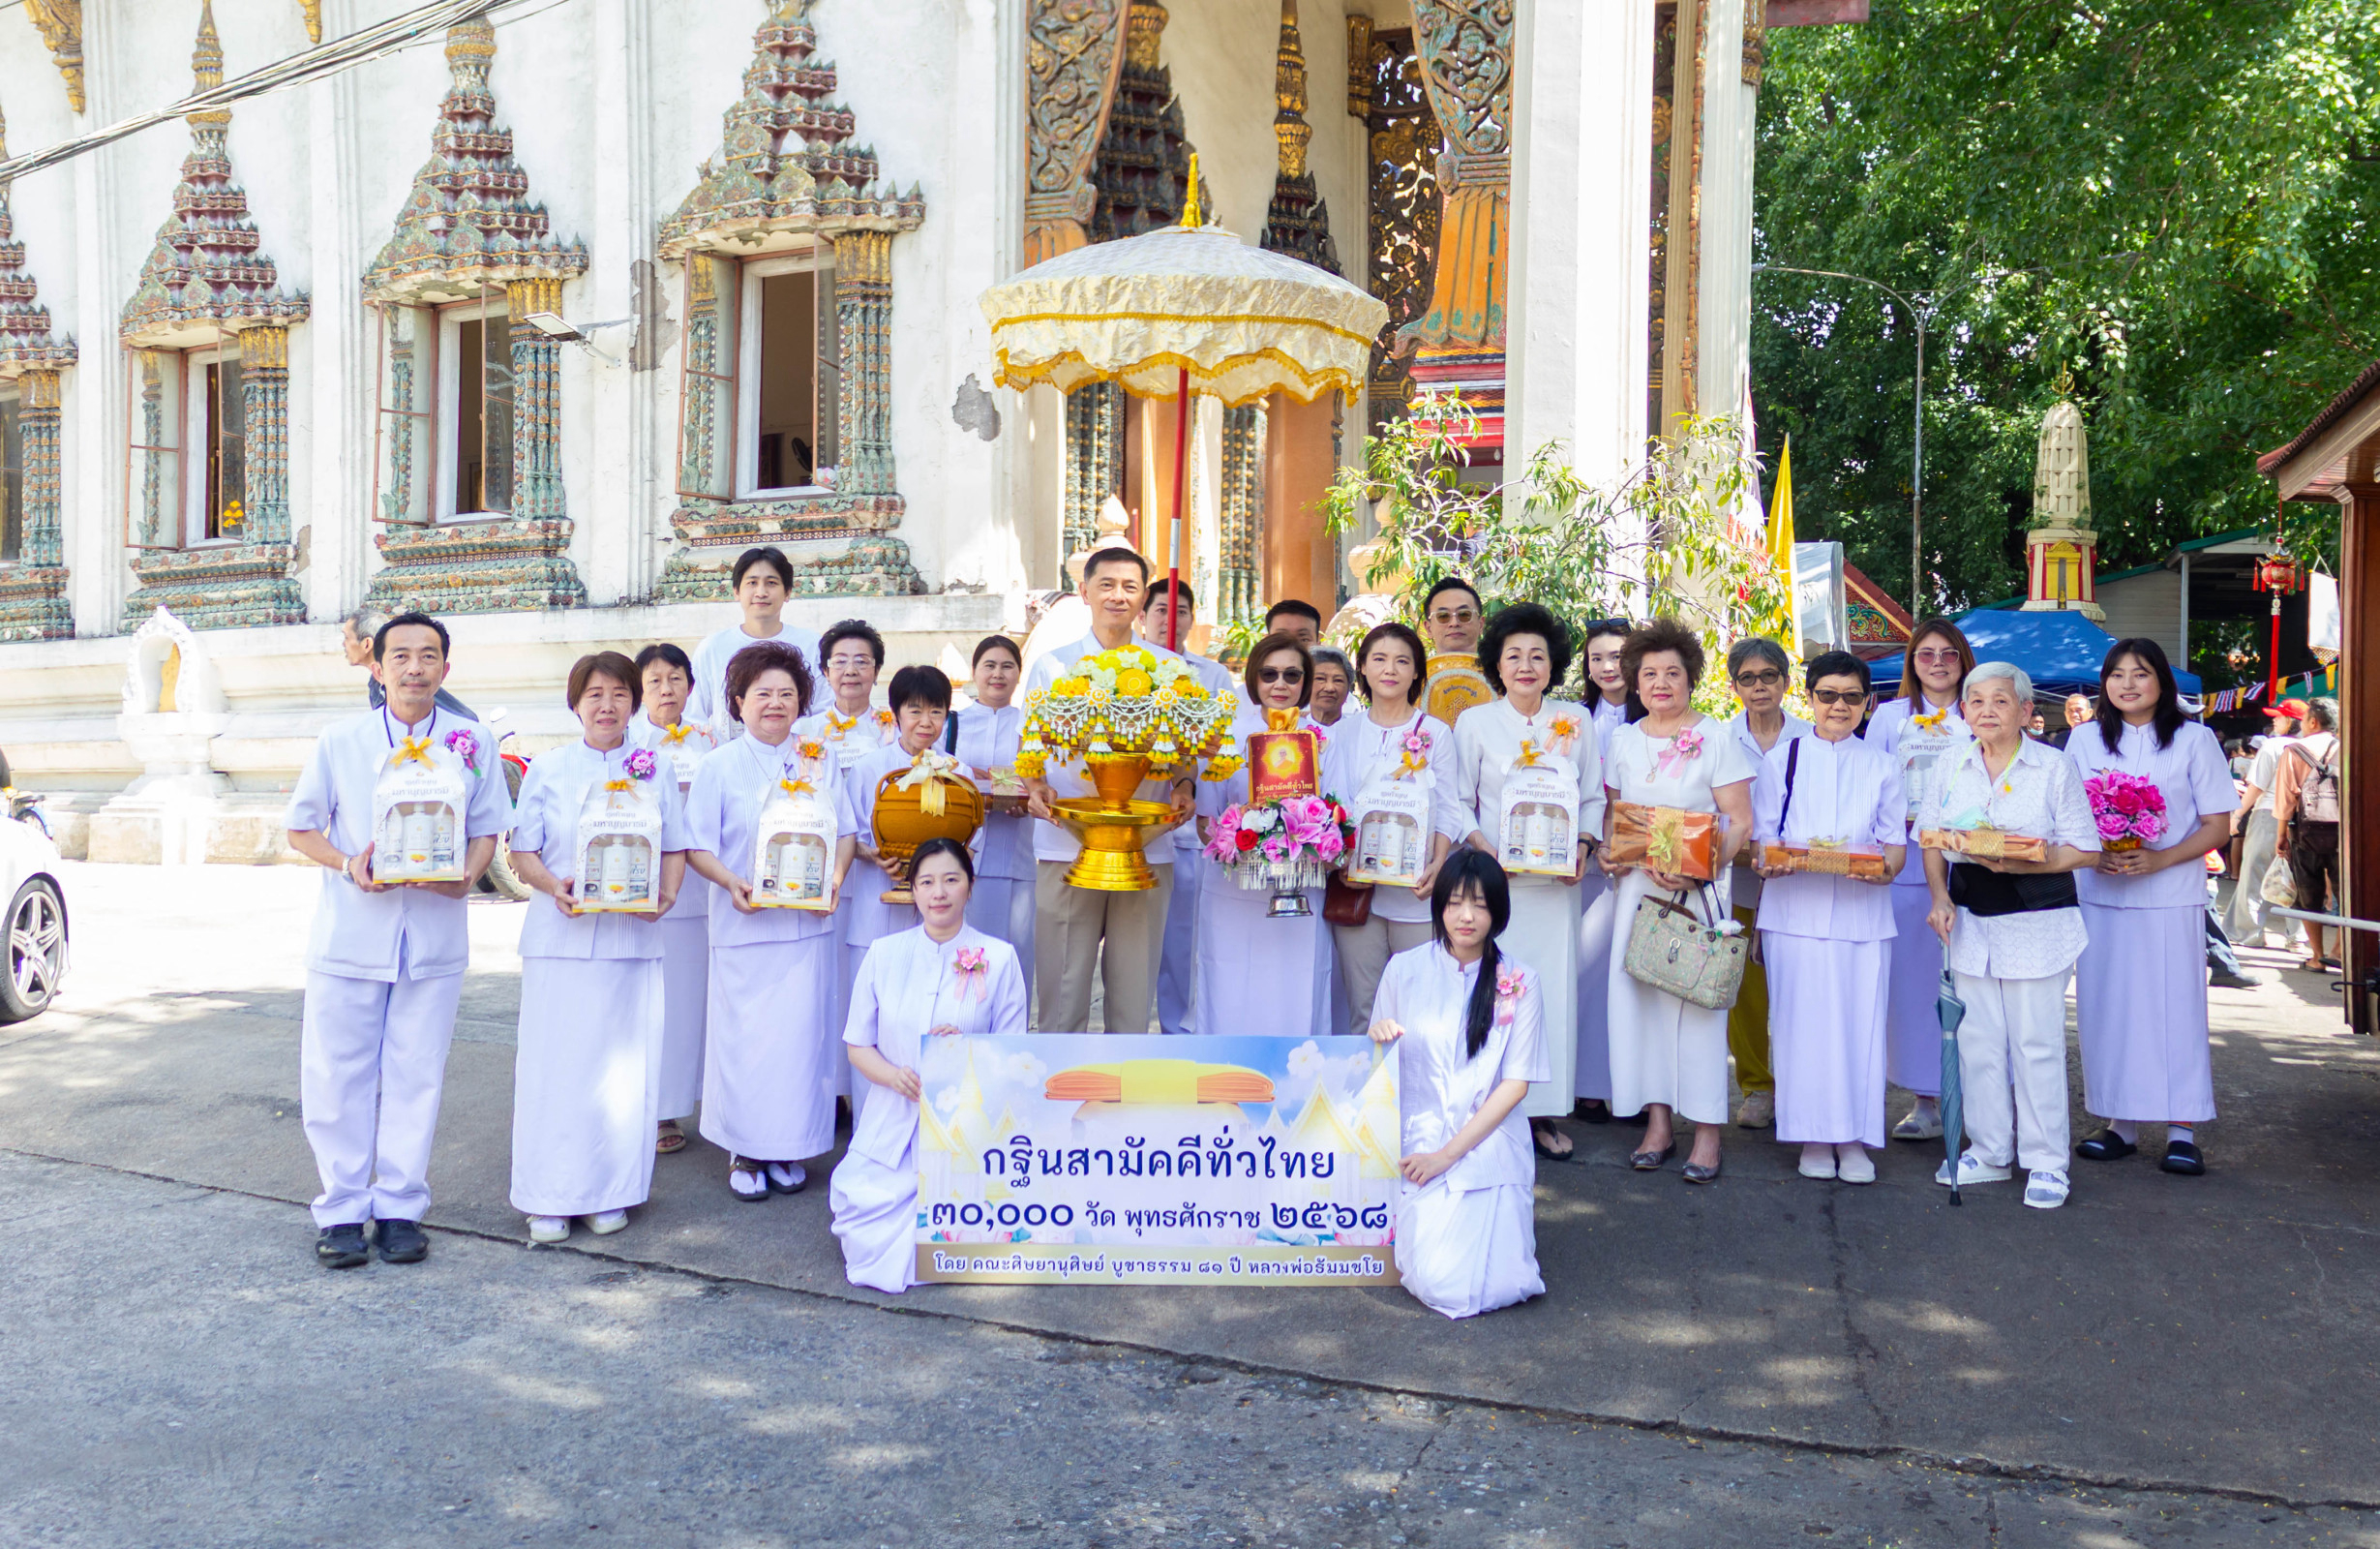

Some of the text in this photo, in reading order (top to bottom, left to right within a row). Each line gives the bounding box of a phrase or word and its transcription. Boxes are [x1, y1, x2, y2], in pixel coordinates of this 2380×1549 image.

[983, 1125, 1335, 1188] กฐินสามัคคีทั่วไทย
[932, 1200, 1388, 1237] ๓๐,๐๐๐ วัด พุทธศักราช ๒๕๖๘
[935, 1253, 1383, 1278] โดย คณะศิษยานุศิษย์ บูชาธรรม ๘๑ ปี หลวงพ่อธัมมชโย
